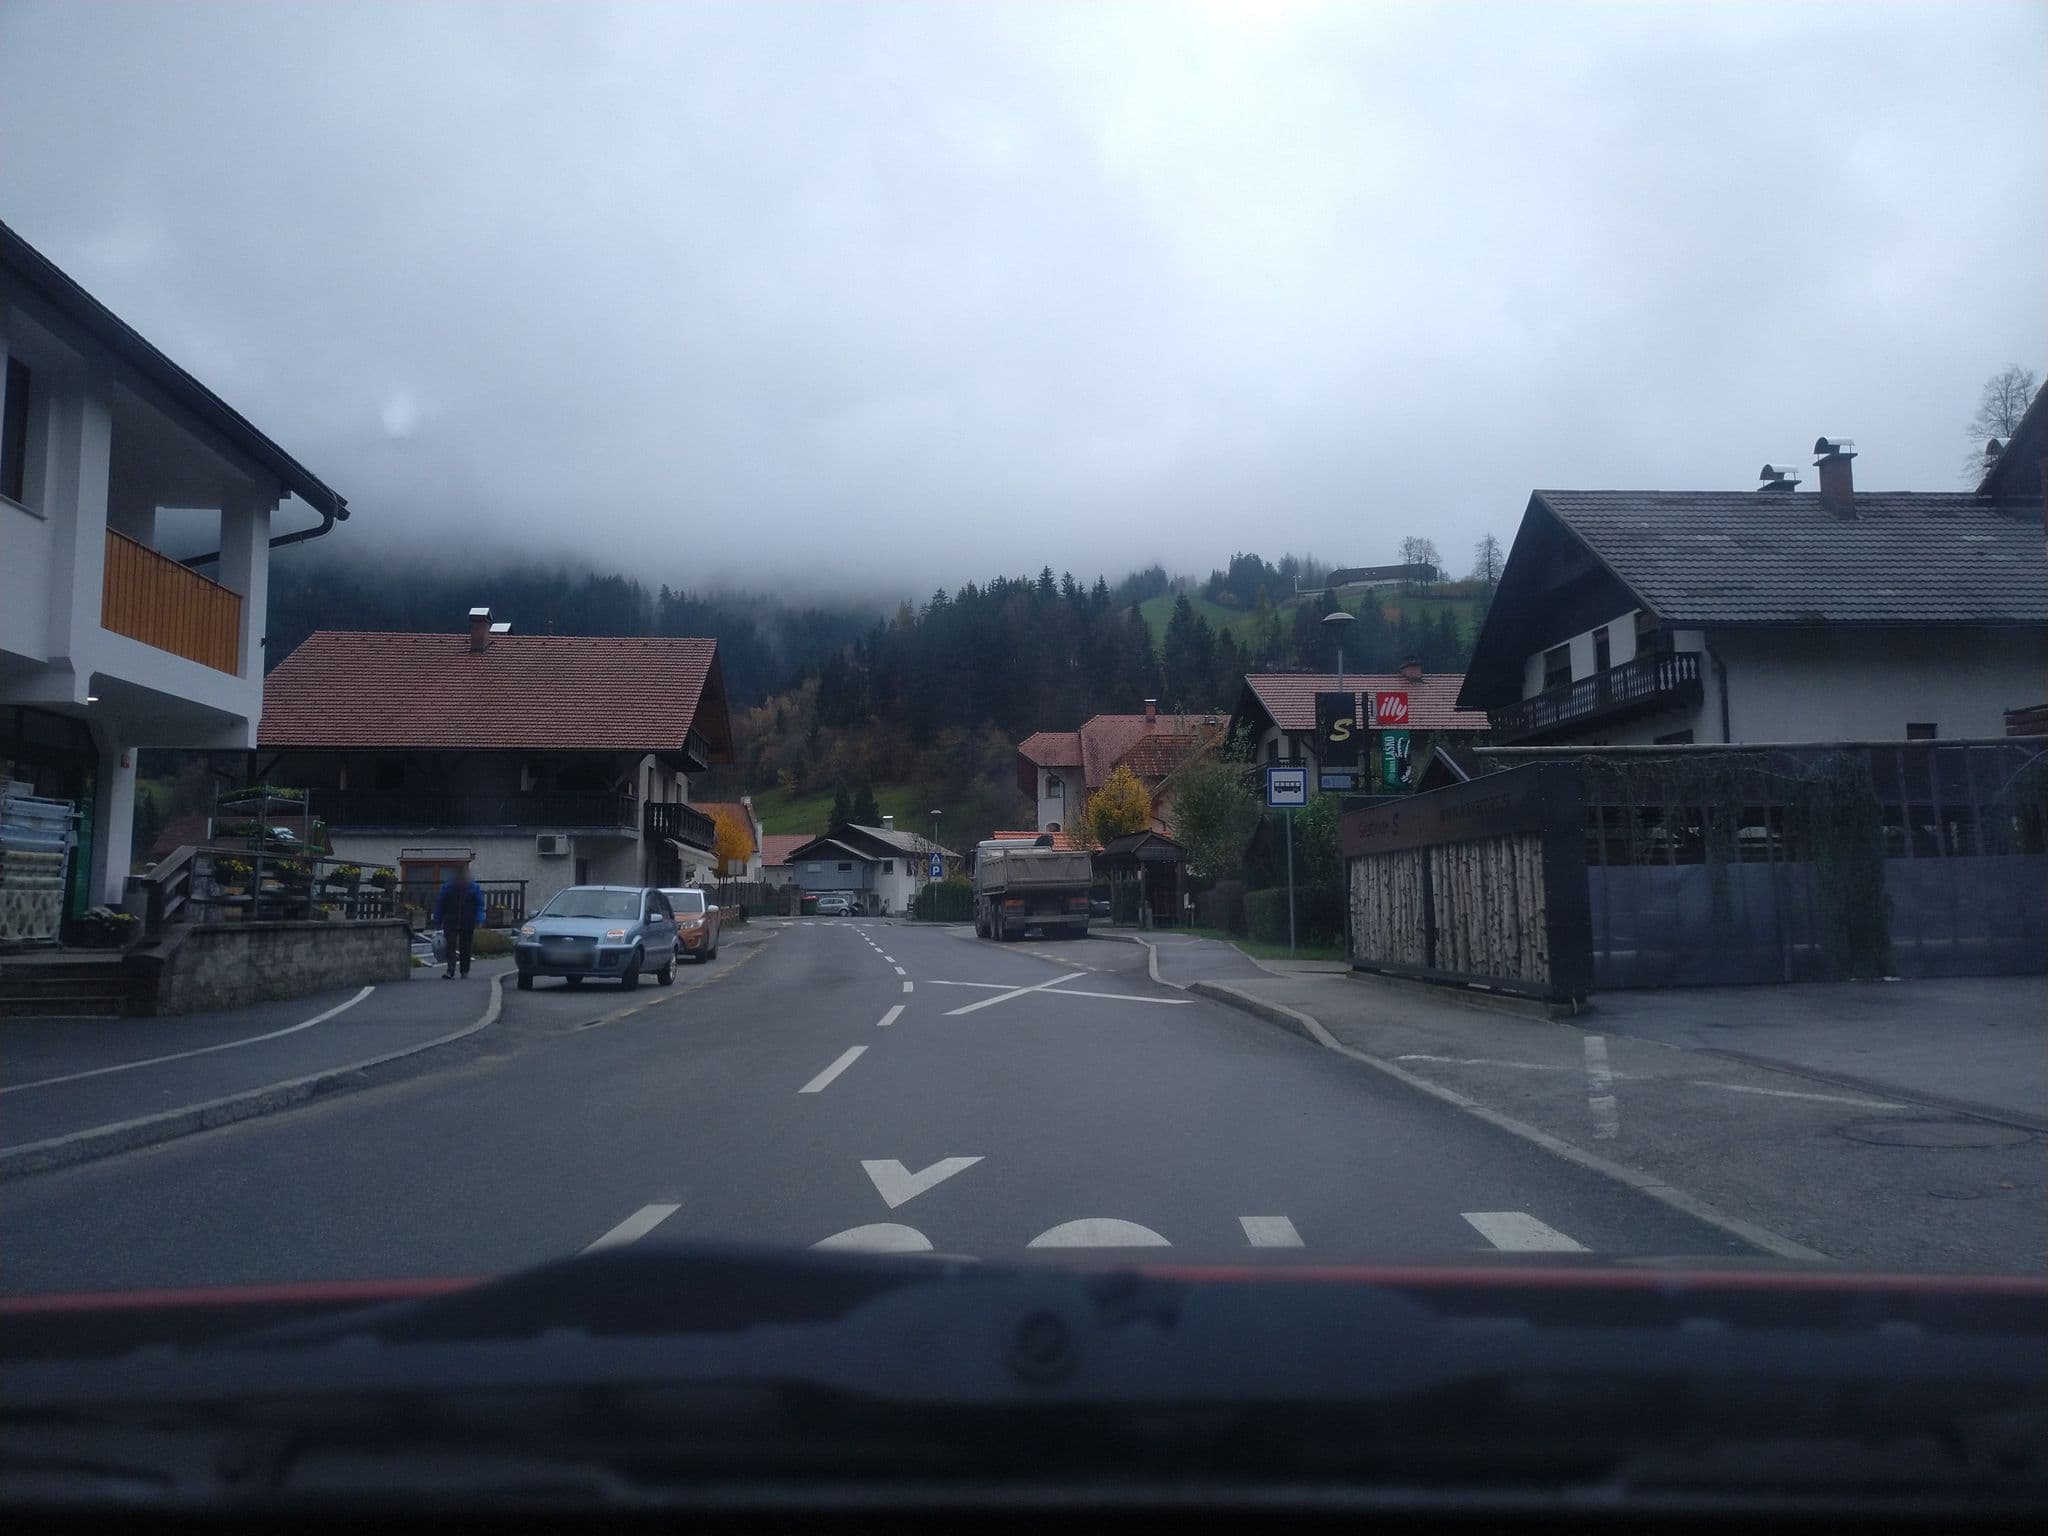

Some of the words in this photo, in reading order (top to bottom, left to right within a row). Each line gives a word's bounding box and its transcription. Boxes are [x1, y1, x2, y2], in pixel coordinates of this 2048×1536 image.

[1380, 696, 1407, 722] illy
[1329, 718, 1354, 742] S
[932, 866, 940, 876] P
